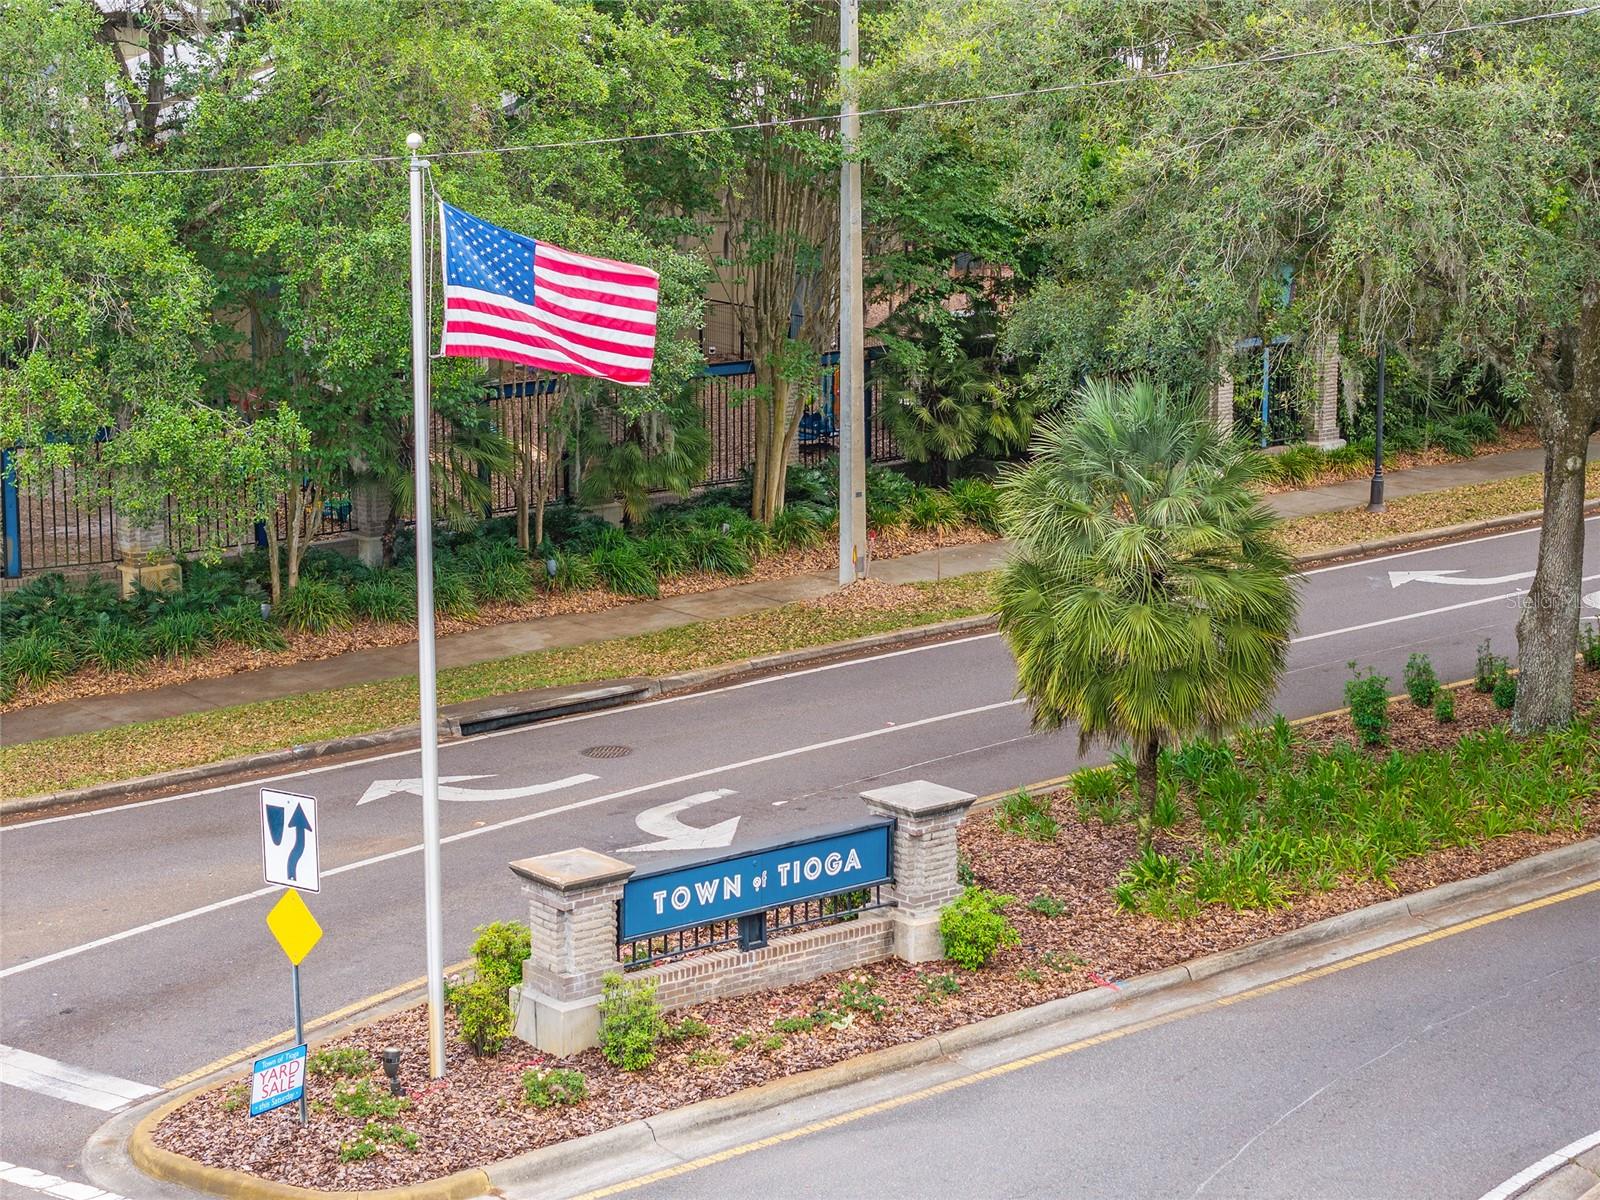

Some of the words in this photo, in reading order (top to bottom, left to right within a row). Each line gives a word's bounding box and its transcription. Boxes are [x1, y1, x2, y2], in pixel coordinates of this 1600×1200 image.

[653, 874, 741, 914] TOWN
[753, 870, 767, 892] of
[778, 849, 861, 887] TIOGA
[260, 1060, 299, 1085] YARD
[261, 1075, 295, 1099] SALE
[271, 1092, 294, 1105] Saturday
